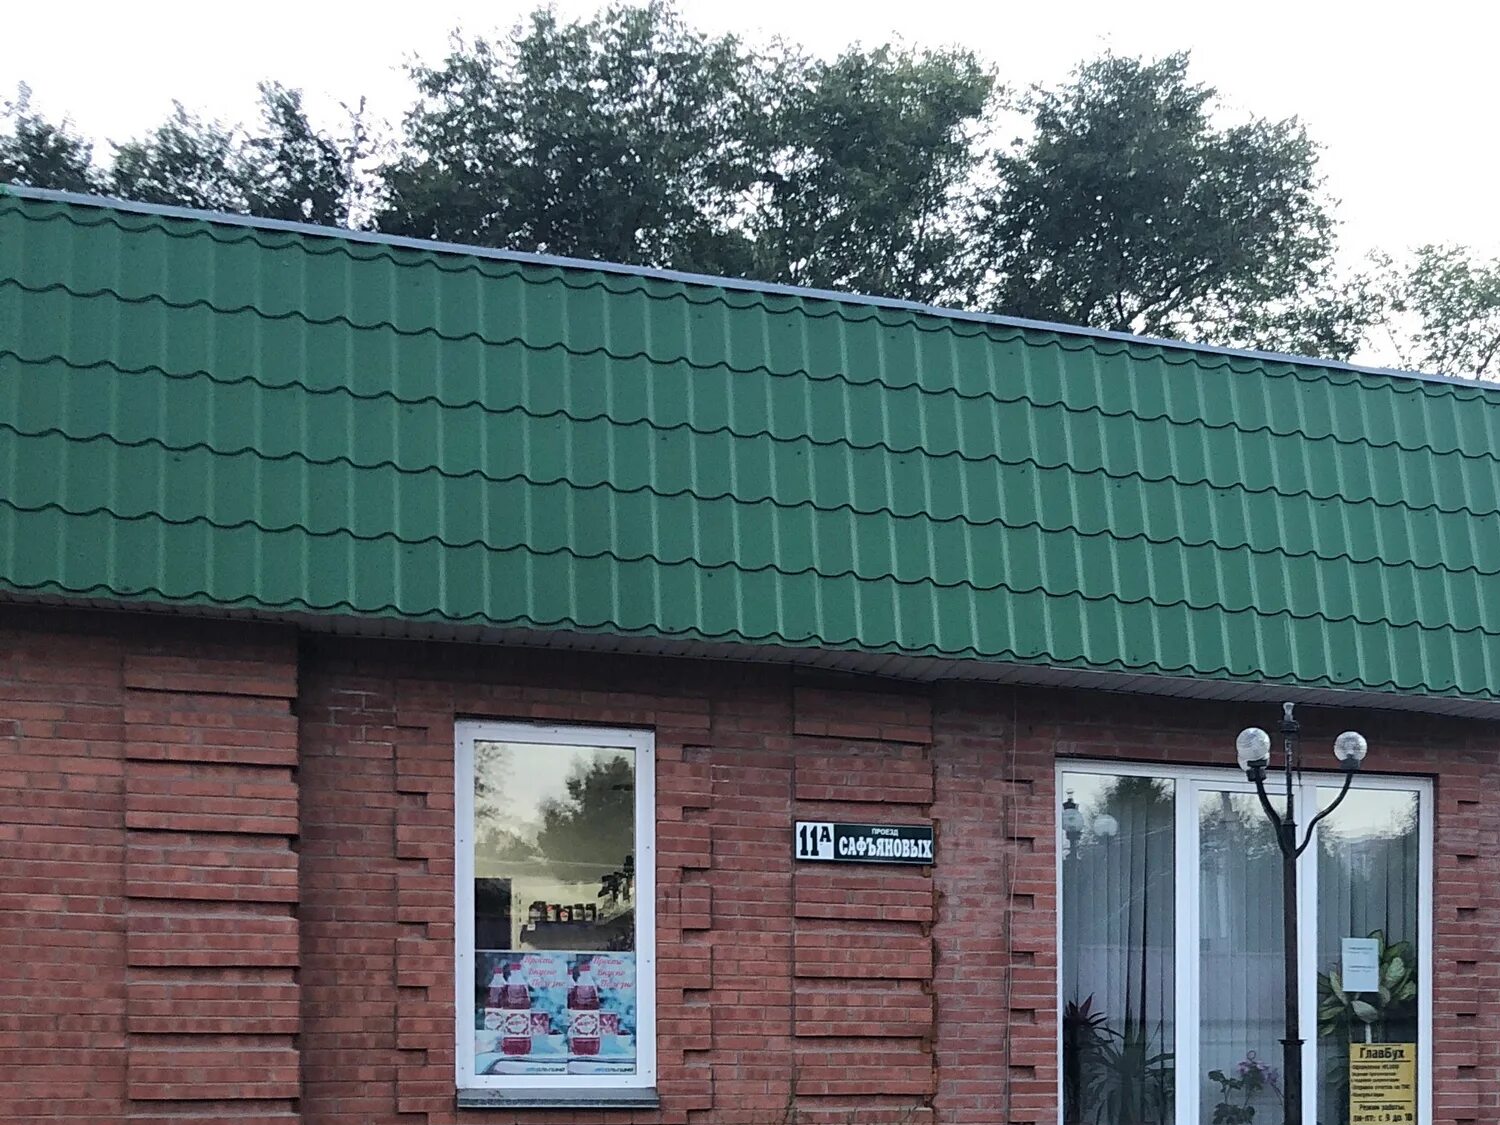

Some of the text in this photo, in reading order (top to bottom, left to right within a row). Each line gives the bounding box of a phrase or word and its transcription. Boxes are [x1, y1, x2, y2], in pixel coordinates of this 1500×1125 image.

[871, 828, 899, 836] ПРОЕЗД
[839, 836, 932, 858] САФЪЯНОВЫХ
[1360, 1047, 1404, 1060] ГлавБух
